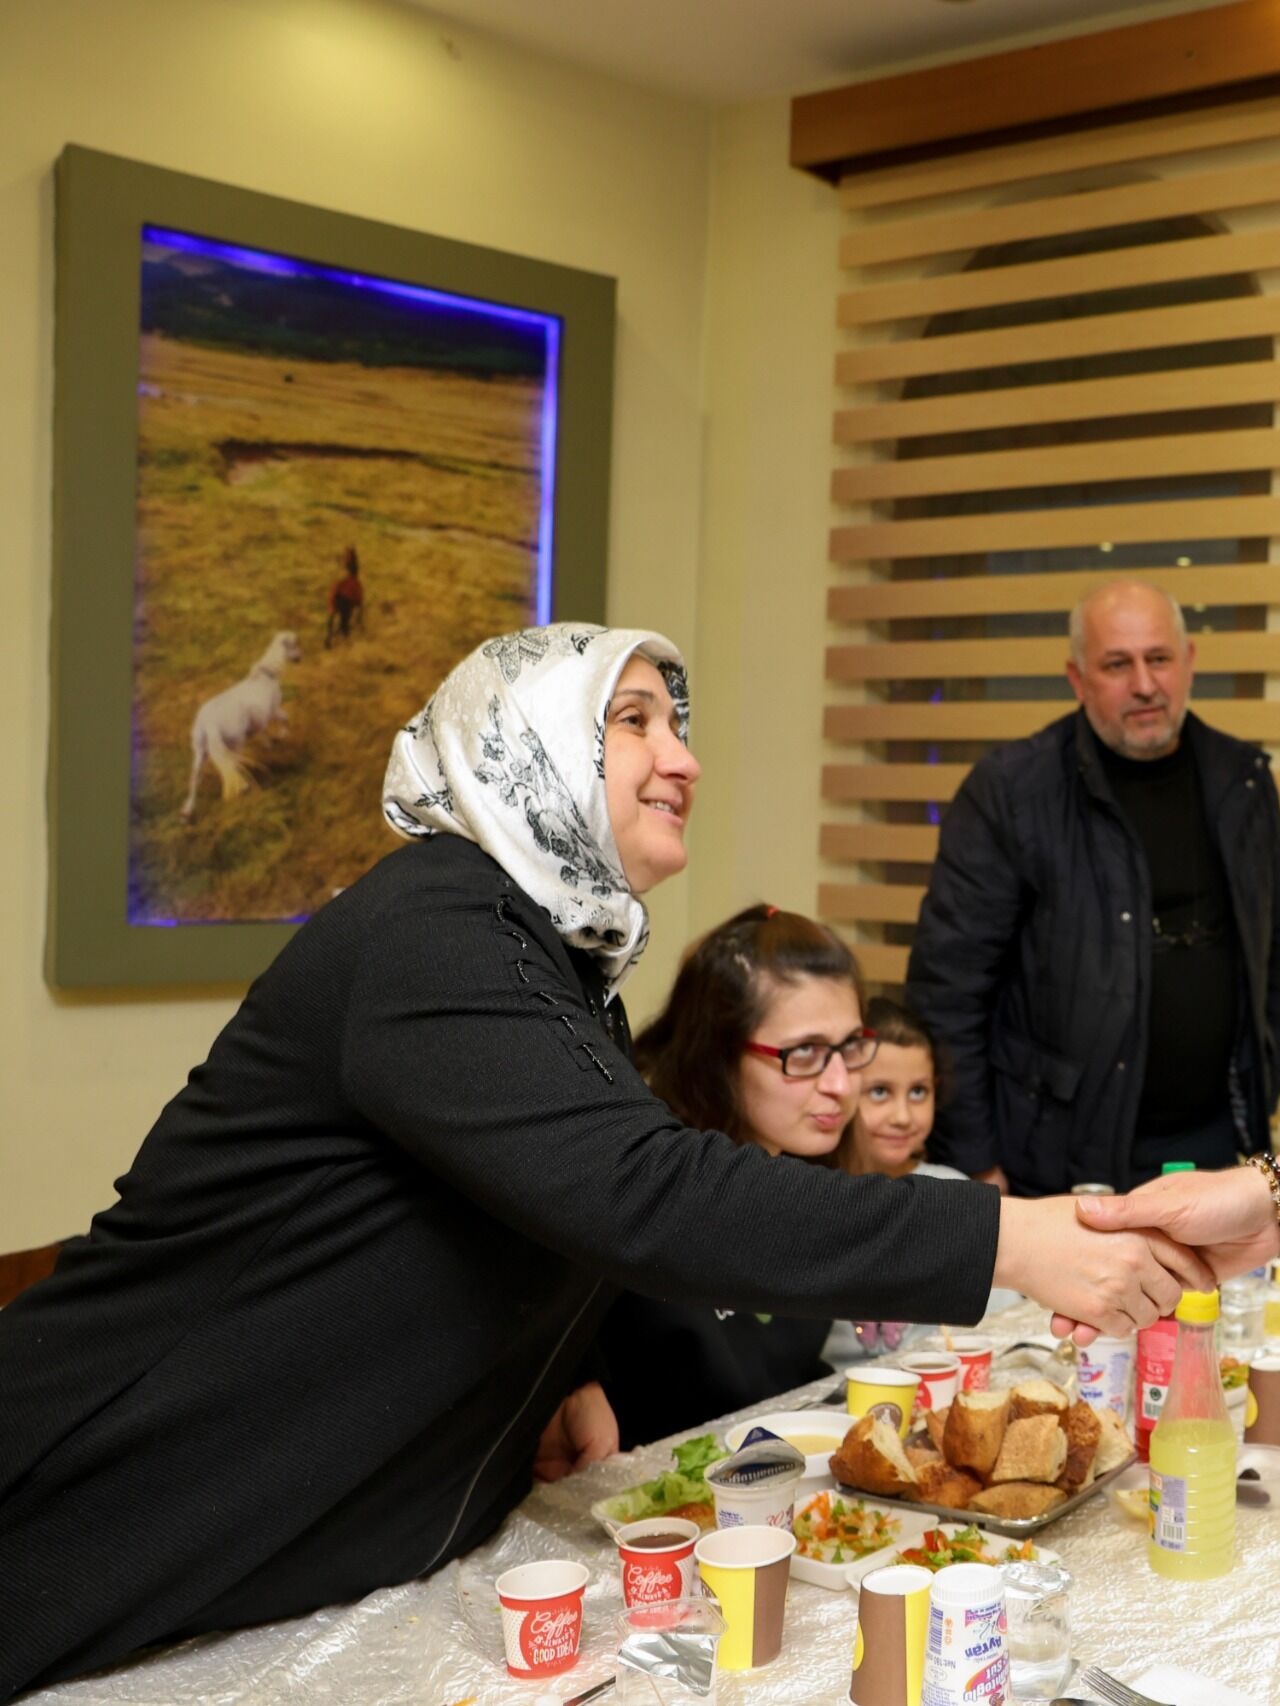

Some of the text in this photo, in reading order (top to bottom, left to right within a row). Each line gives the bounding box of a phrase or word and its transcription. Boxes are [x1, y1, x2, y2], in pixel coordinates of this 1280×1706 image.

[627, 1563, 673, 1594] Coffee
[530, 1610, 579, 1640] Coffee
[533, 1638, 574, 1665] GOOD IDEA
[964, 1635, 1002, 1659] Ayran
